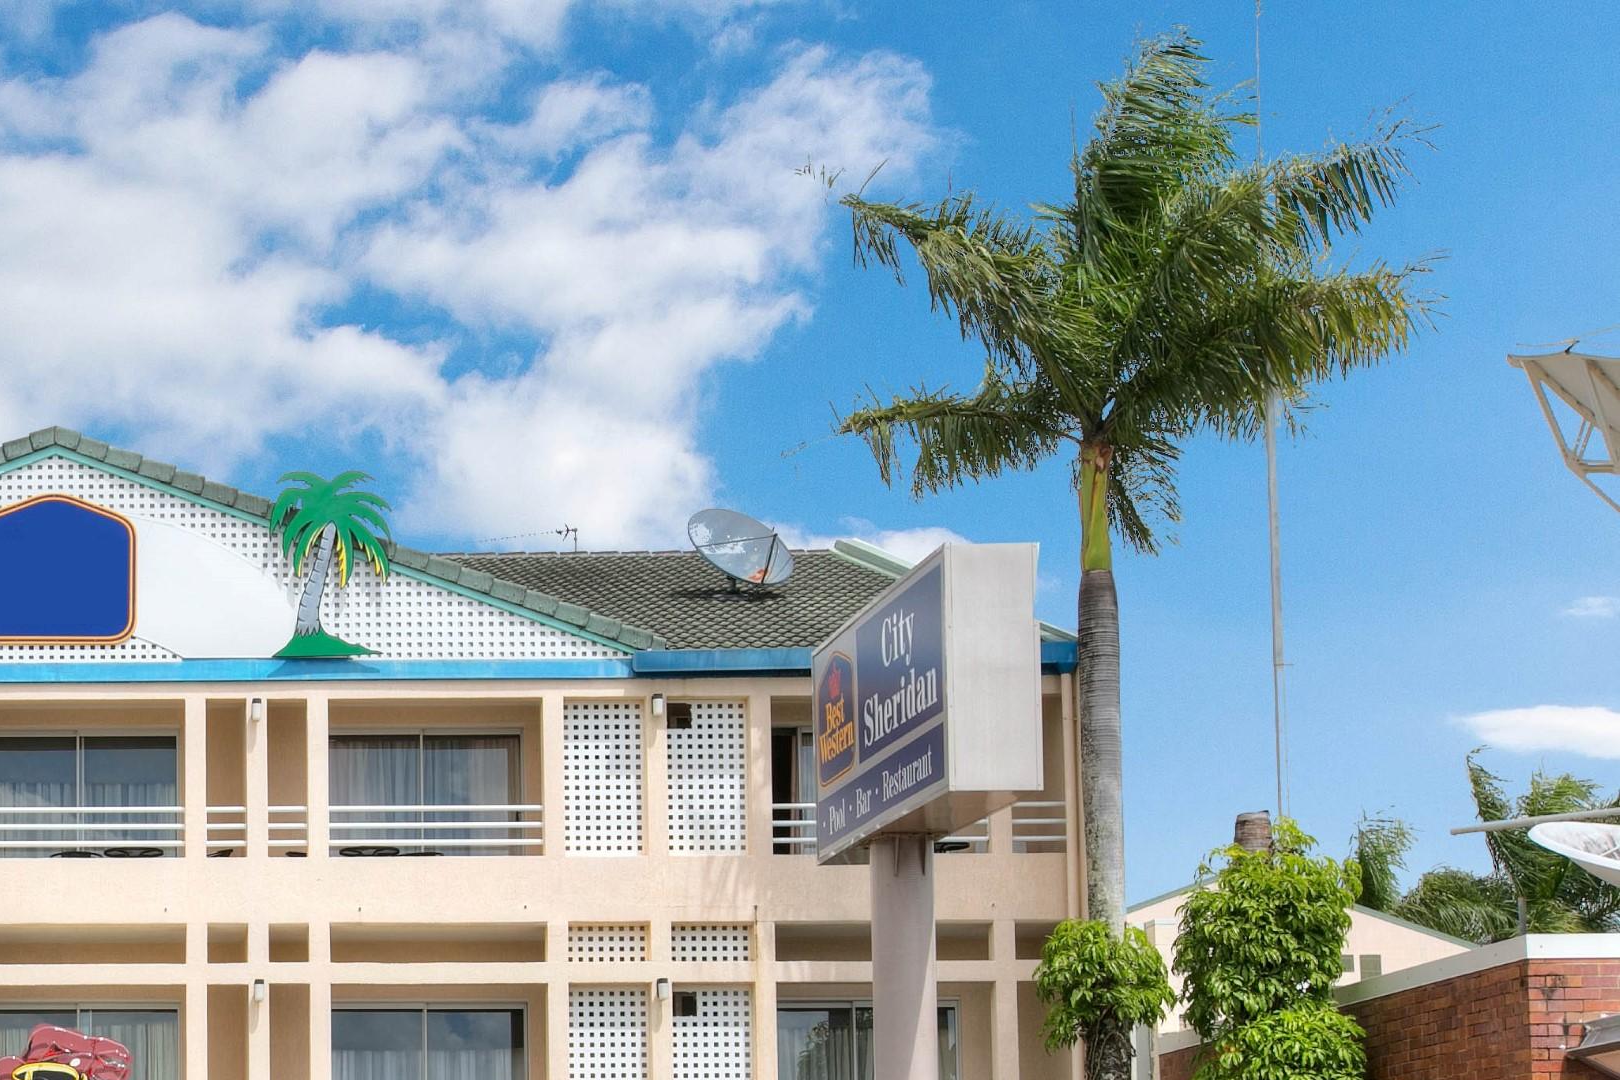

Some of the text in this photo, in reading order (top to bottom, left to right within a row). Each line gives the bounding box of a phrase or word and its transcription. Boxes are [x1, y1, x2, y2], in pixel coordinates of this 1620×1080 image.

[881, 608, 916, 668] City
[826, 692, 845, 733] Best
[863, 667, 938, 749] Sheridan
[819, 720, 855, 765] Western
[829, 744, 933, 835] Pool Bar Restaurant
